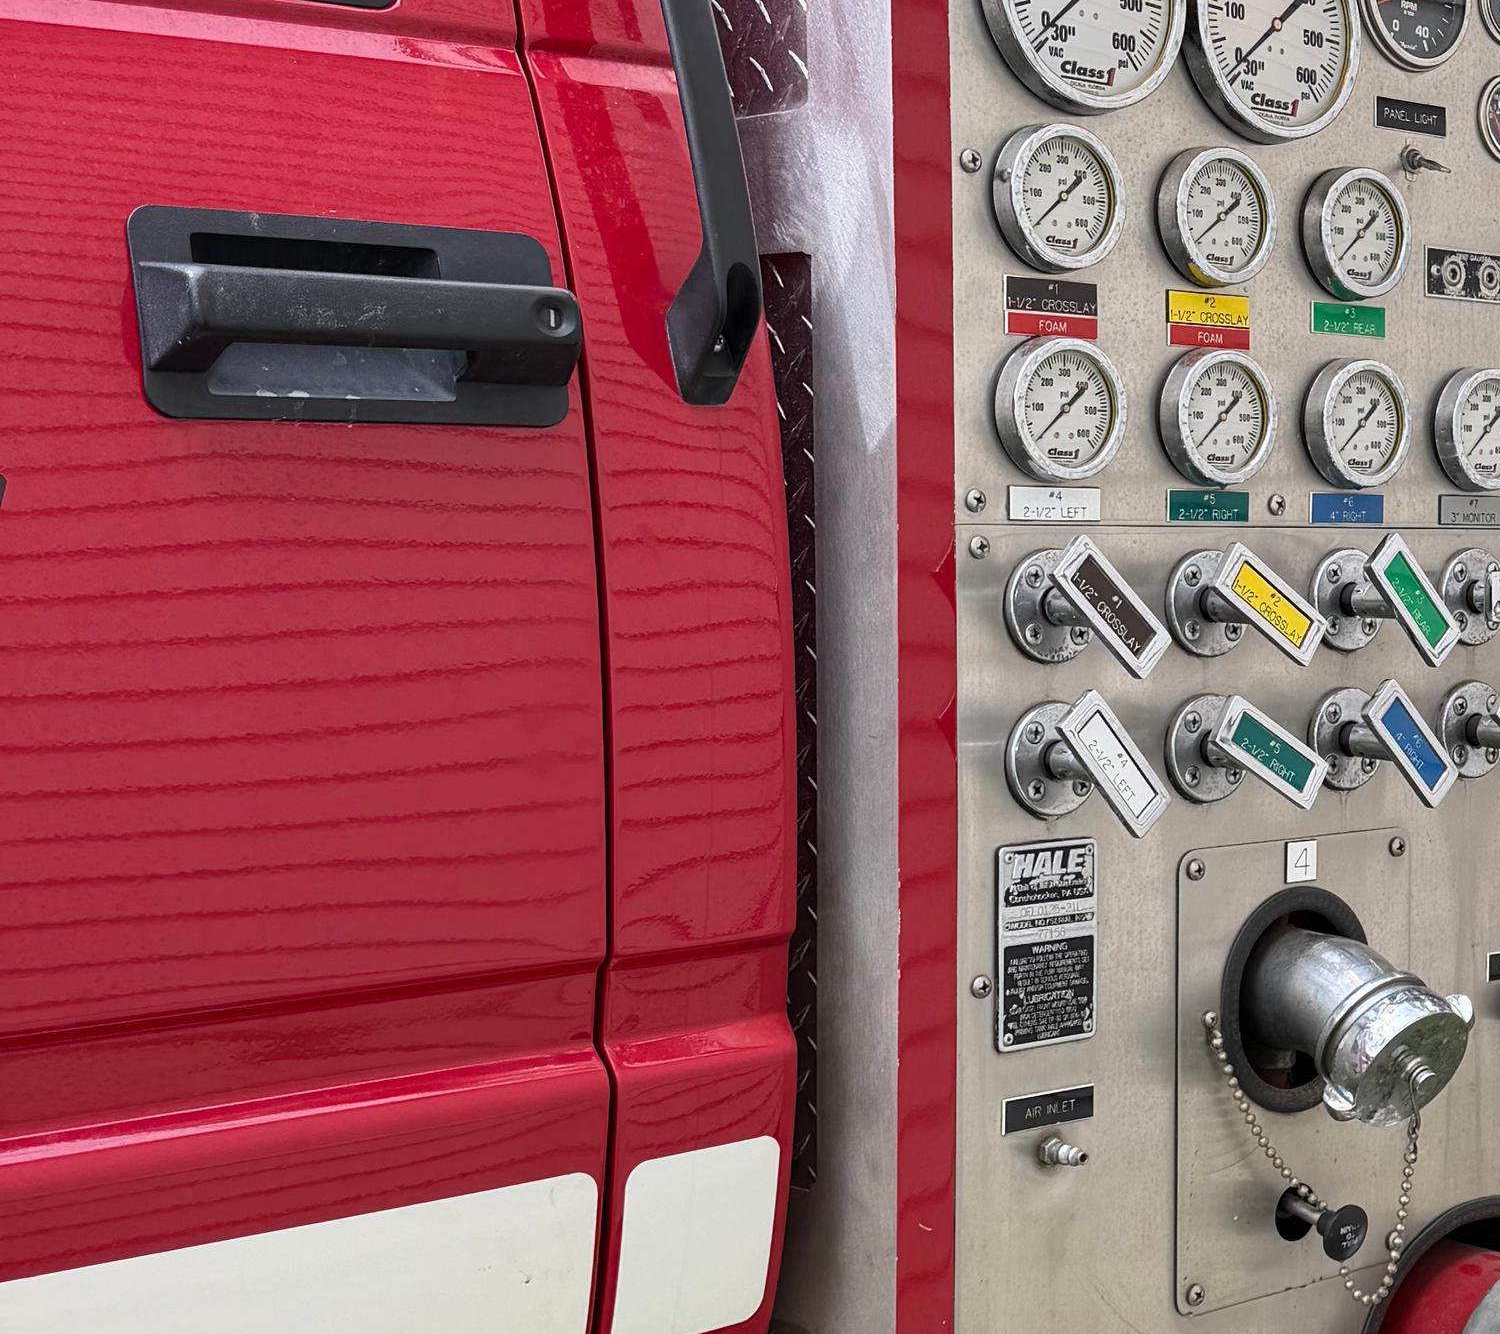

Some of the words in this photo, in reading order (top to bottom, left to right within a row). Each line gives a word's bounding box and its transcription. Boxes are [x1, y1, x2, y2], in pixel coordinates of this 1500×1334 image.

[1225, 1, 1244, 20] 100
[1401, 1, 1417, 12] RPM
[1392, 20, 1399, 31] 0
[1415, 26, 1429, 38] 40
[1112, 32, 1135, 52] 600
[1303, 29, 1323, 48] 500
[1049, 46, 1063, 58] VAC
[1118, 57, 1128, 69] psi
[1296, 67, 1316, 85] 600
[1241, 80, 1254, 91] VAC
[1384, 107, 1409, 122] PANEL
[1414, 112, 1437, 125] LIGHT
[1048, 284, 1058, 293] #1
[1042, 299, 1096, 313] CROSSLAY
[1204, 298, 1215, 308] #2
[1345, 308, 1355, 318] #3
[1200, 313, 1248, 326] CROSSLAY
[1039, 320, 1067, 332] FOAM
[1353, 323, 1375, 334] REAR
[1198, 332, 1222, 343] FOAM
[1058, 368, 1071, 378] 300
[1041, 377, 1053, 387] 200
[1032, 402, 1044, 412] 100
[1085, 406, 1097, 415] 500
[1077, 429, 1090, 438] 600
[1049, 491, 1062, 501] #4
[1204, 494, 1215, 505] #5
[1344, 497, 1353, 507] #6
[1469, 499, 1479, 509] #7
[1061, 507, 1087, 519] LEFT
[1212, 509, 1239, 520] RIGHT
[1343, 511, 1366, 522] RIGHT
[1464, 513, 1496, 523] MONITOR
[1112, 594, 1123, 609] #1
[1270, 593, 1281, 606] #2
[1415, 589, 1424, 604] #3
[1097, 601, 1141, 652] CROSSLAY
[1259, 603, 1301, 643] CROSSLAY
[1412, 608, 1431, 635] REAR
[1269, 740, 1281, 754] #5
[1117, 752, 1127, 767] #4
[1405, 744, 1424, 770] RIGHT
[1270, 758, 1296, 781] RIGHT
[1114, 773, 1135, 802] LEFT
[1012, 848, 1086, 879] HALE
[1294, 848, 1310, 875] 4
[1032, 942, 1068, 954] WARNING
[1023, 989, 1074, 1006] LUBRICATION
[1025, 1106, 1041, 1119] AIR
[1047, 1099, 1076, 1114] INLET
